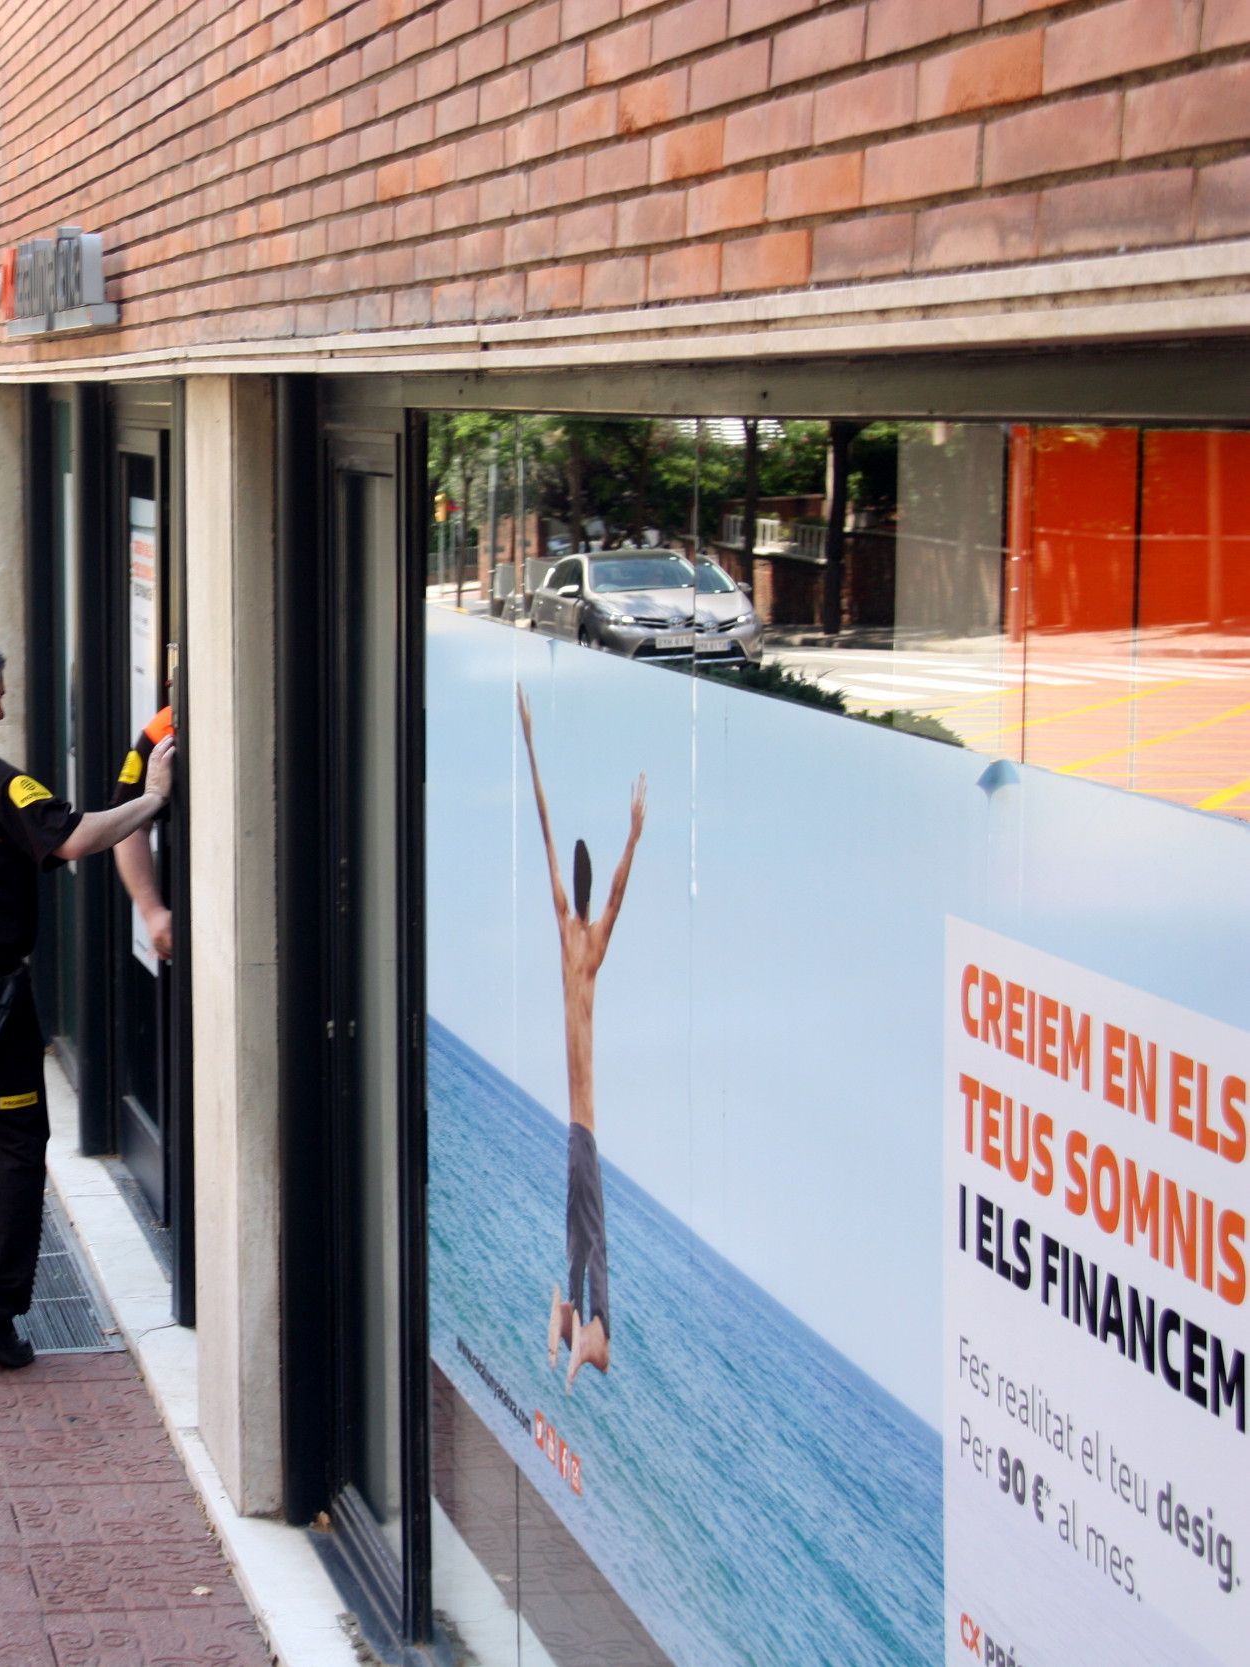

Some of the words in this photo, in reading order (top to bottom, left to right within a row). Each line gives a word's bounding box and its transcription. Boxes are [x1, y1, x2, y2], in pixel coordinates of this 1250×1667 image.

[960, 963, 1091, 1092] CREIEM
[1102, 1021, 1157, 1125] EN
[1168, 1049, 1247, 1164] ELS
[958, 1071, 1054, 1197] TEUS
[1064, 1129, 1246, 1306] SOMNIS
[958, 1183, 967, 1252] I
[975, 1193, 1031, 1291] ELS
[1040, 1231, 1246, 1435] FINANCEM
[959, 1334, 990, 1398] Fes
[997, 1372, 1074, 1461] realitat
[1081, 1429, 1102, 1483] el
[1110, 1444, 1148, 1517] teu
[1156, 1480, 1242, 1594] desig.
[960, 1415, 993, 1479] Per
[997, 1446, 1027, 1506] 90
[1058, 1499, 1079, 1551] al
[1086, 1523, 1142, 1602] mes.
[959, 1612, 981, 1659] CX
